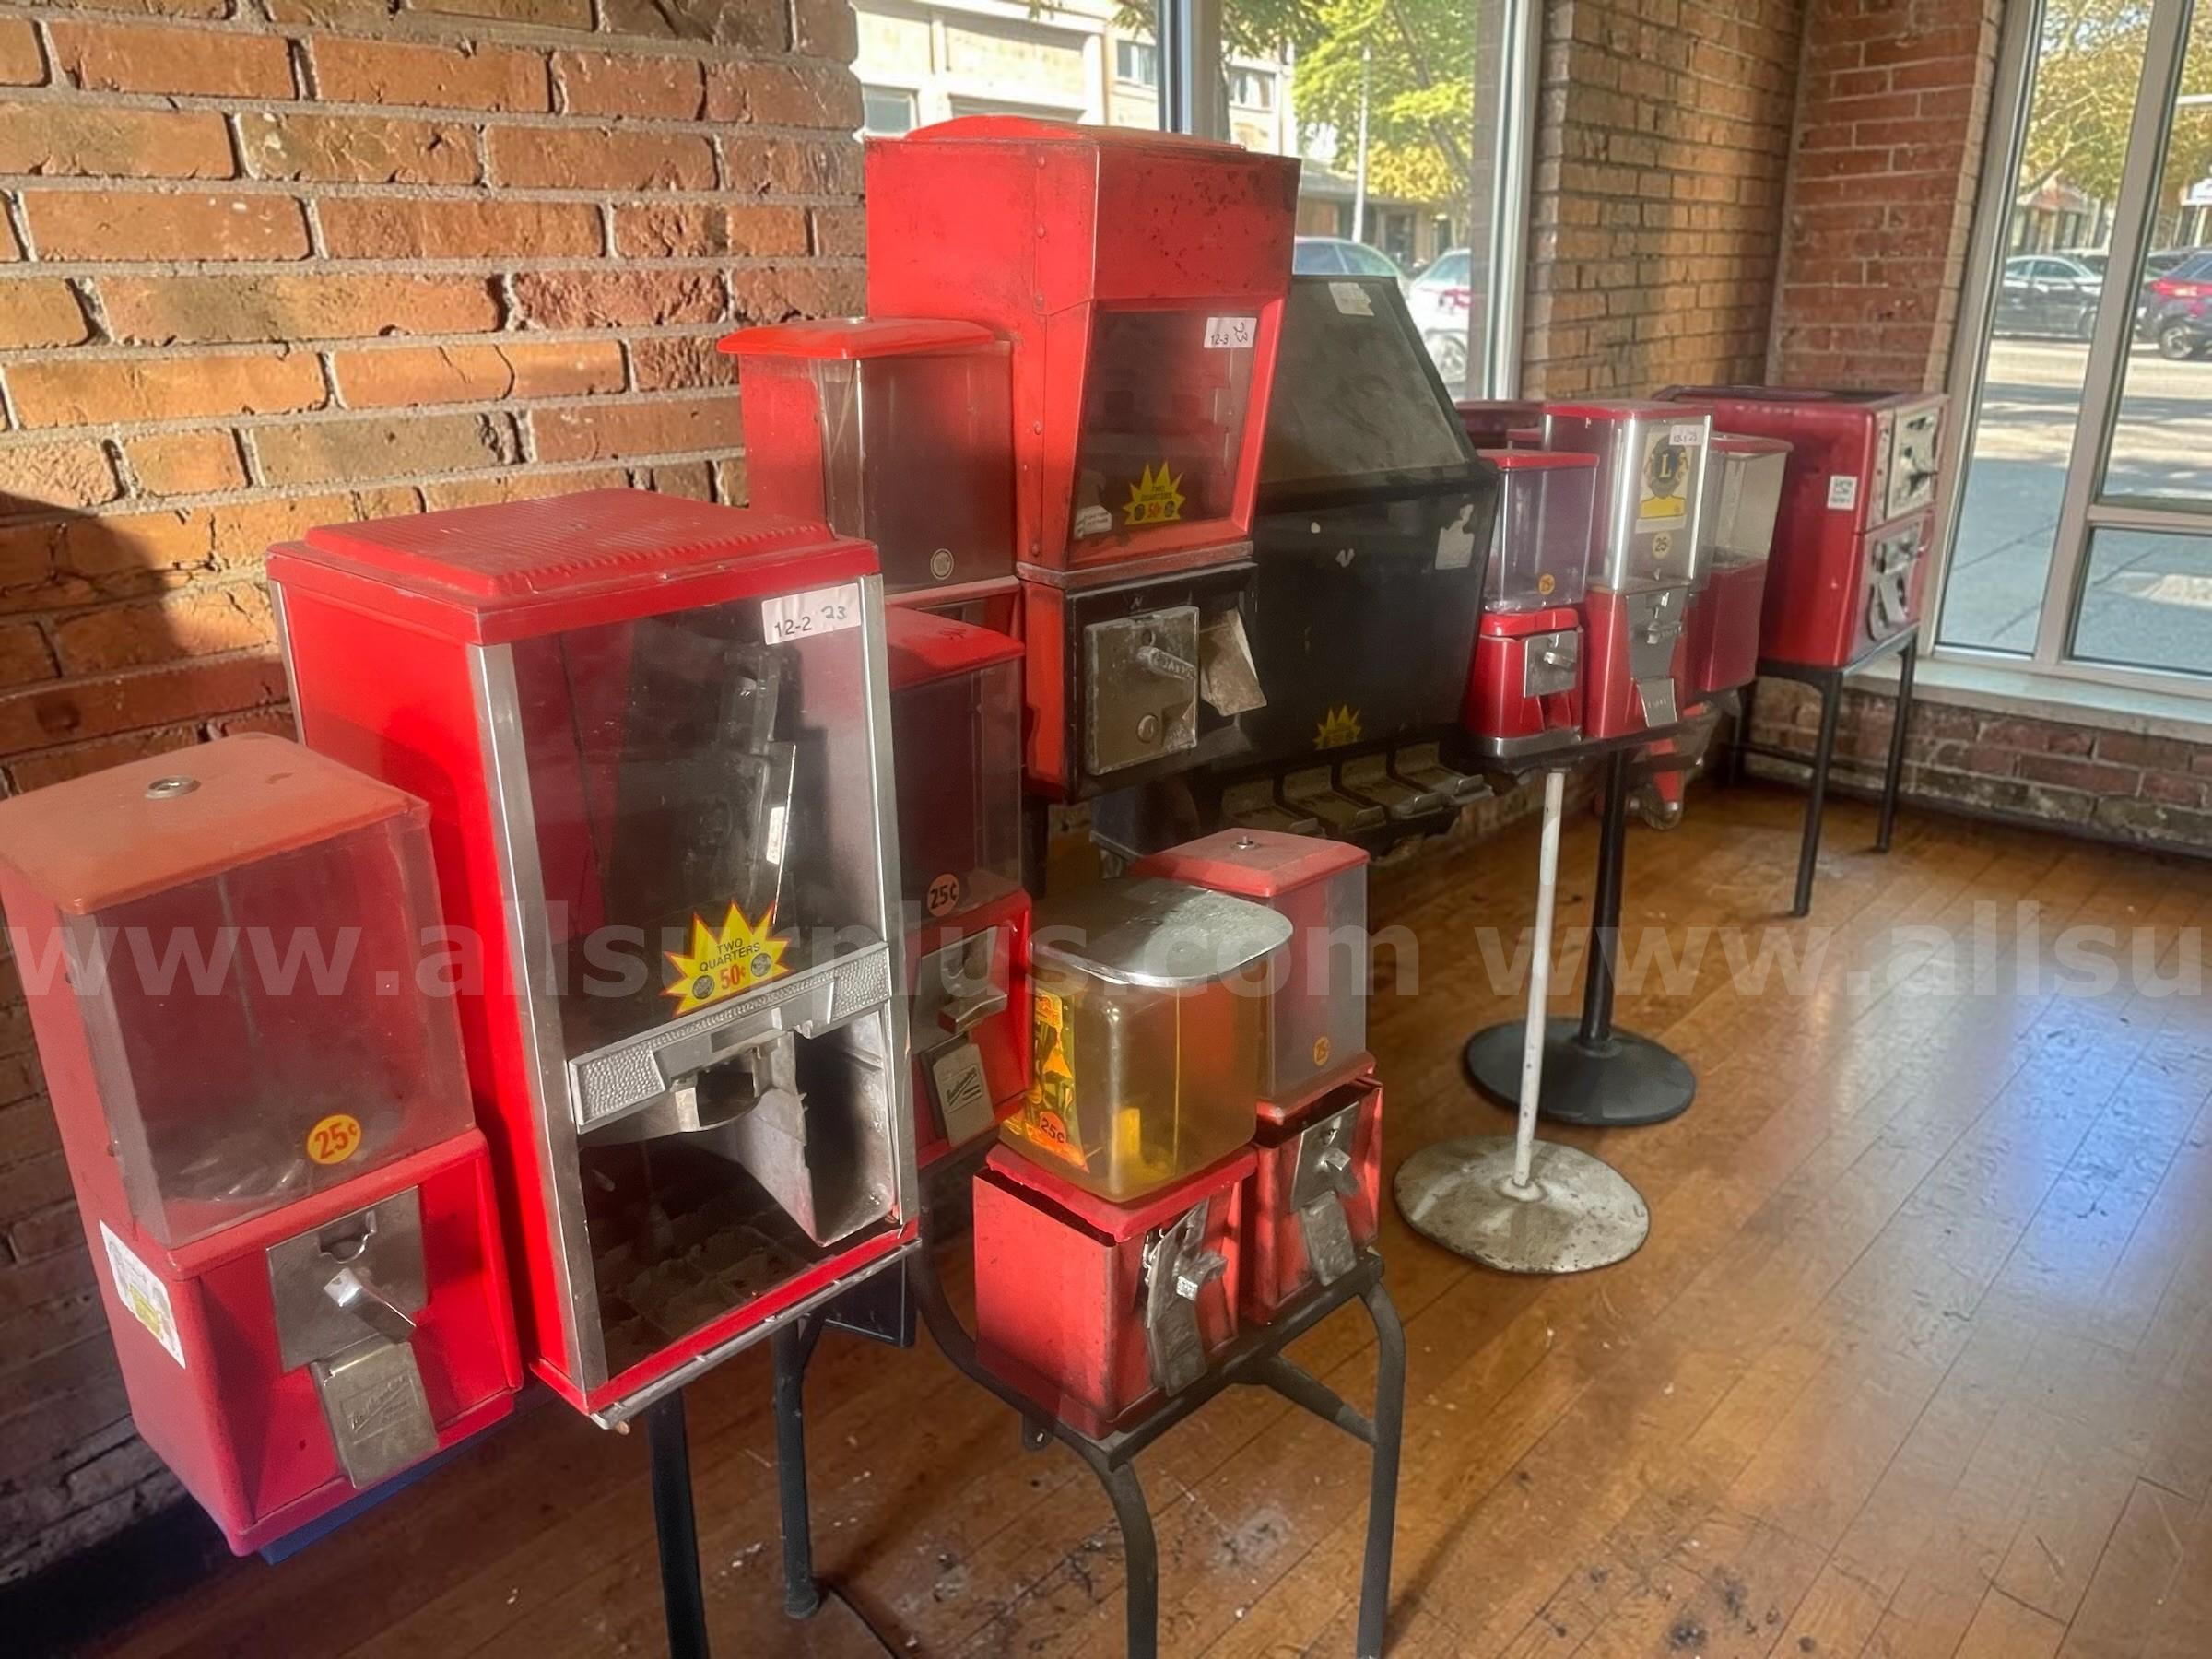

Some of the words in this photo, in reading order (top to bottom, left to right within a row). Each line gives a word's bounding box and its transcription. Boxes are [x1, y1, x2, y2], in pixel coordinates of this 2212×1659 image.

[1210, 334, 1229, 345] 12-3
[821, 606, 846, 619] 23
[774, 616, 812, 637] 12-2
[700, 942, 760, 971] QUARTERS
[717, 938, 744, 954] TWO
[720, 964, 746, 989] 50¢
[314, 1122, 357, 1159] 25¢
